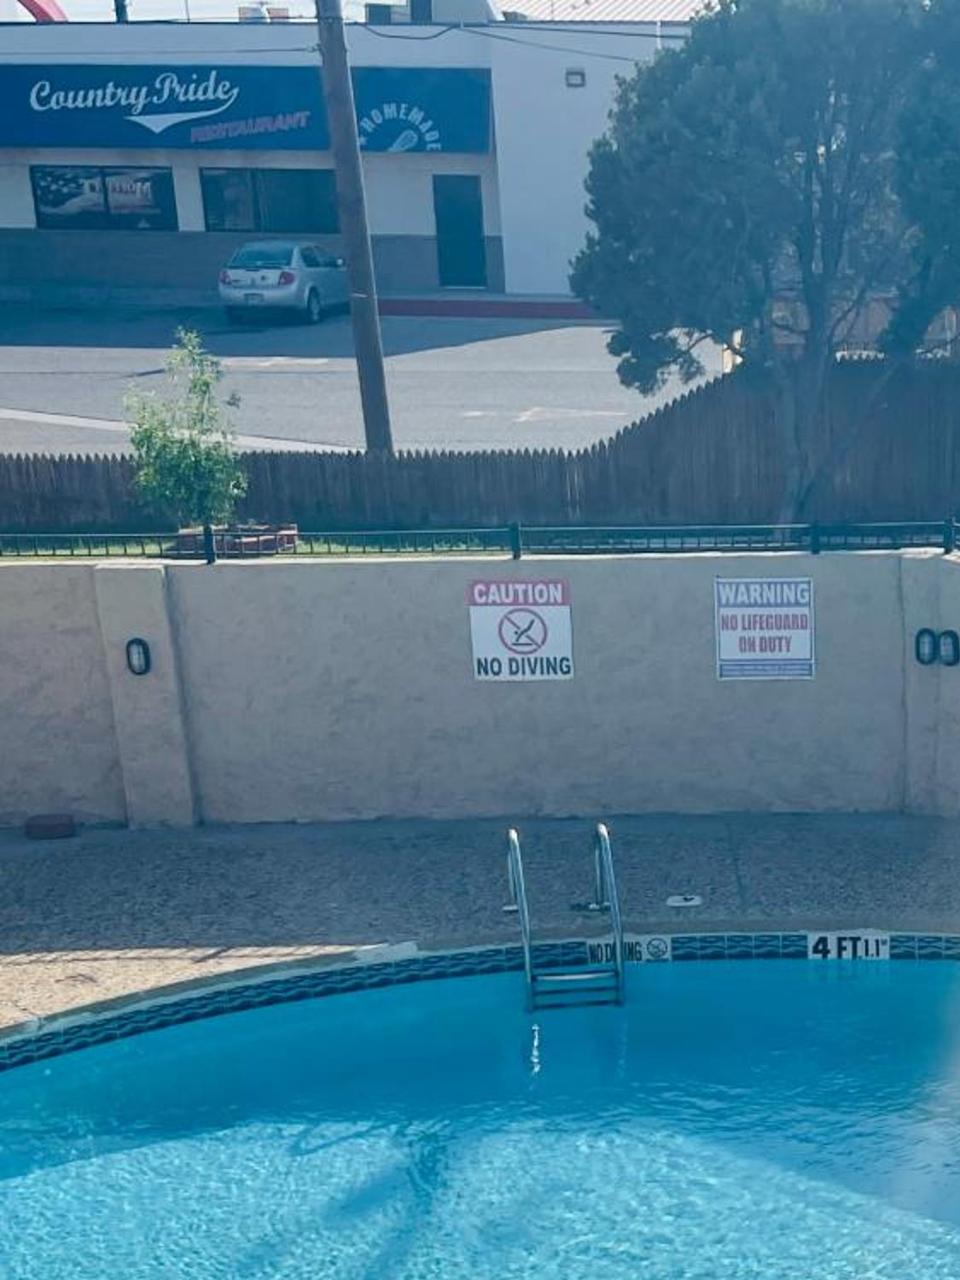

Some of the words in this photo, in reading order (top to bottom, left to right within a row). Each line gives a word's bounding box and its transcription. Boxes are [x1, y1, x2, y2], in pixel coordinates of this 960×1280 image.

[30, 81, 150, 115] Country
[153, 70, 239, 105] Pride
[360, 102, 442, 151] HOMEMADE
[474, 583, 562, 604] CAUTION
[720, 583, 809, 604] WARNING
[722, 614, 738, 631] NO
[742, 614, 808, 631] LIFEGUARD
[739, 636, 757, 653] ON
[760, 636, 792, 653] DUTY
[477, 657, 502, 676] NO
[508, 656, 571, 676] DIVING
[589, 943, 603, 964] NO
[812, 936, 831, 959] 4
